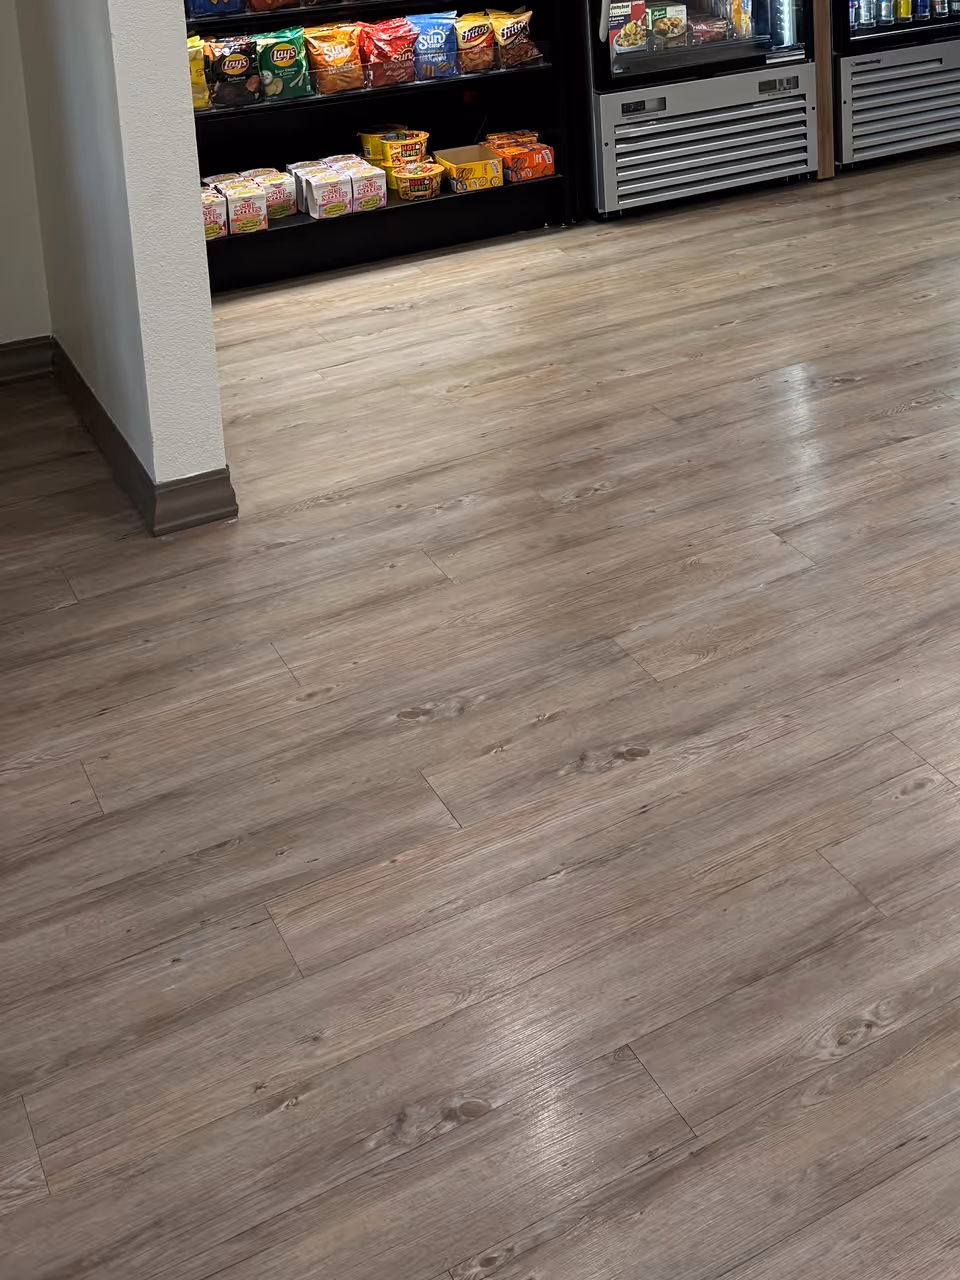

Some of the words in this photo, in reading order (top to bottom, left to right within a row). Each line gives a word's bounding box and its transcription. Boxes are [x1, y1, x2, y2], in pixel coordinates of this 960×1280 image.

[461, 24, 488, 42] Fritos
[418, 35, 446, 50] Sun
[273, 48, 296, 61] Lay's
[224, 57, 247, 70] Lay's
[402, 149, 420, 157] SPICY
[410, 184, 430, 192] SPICY
